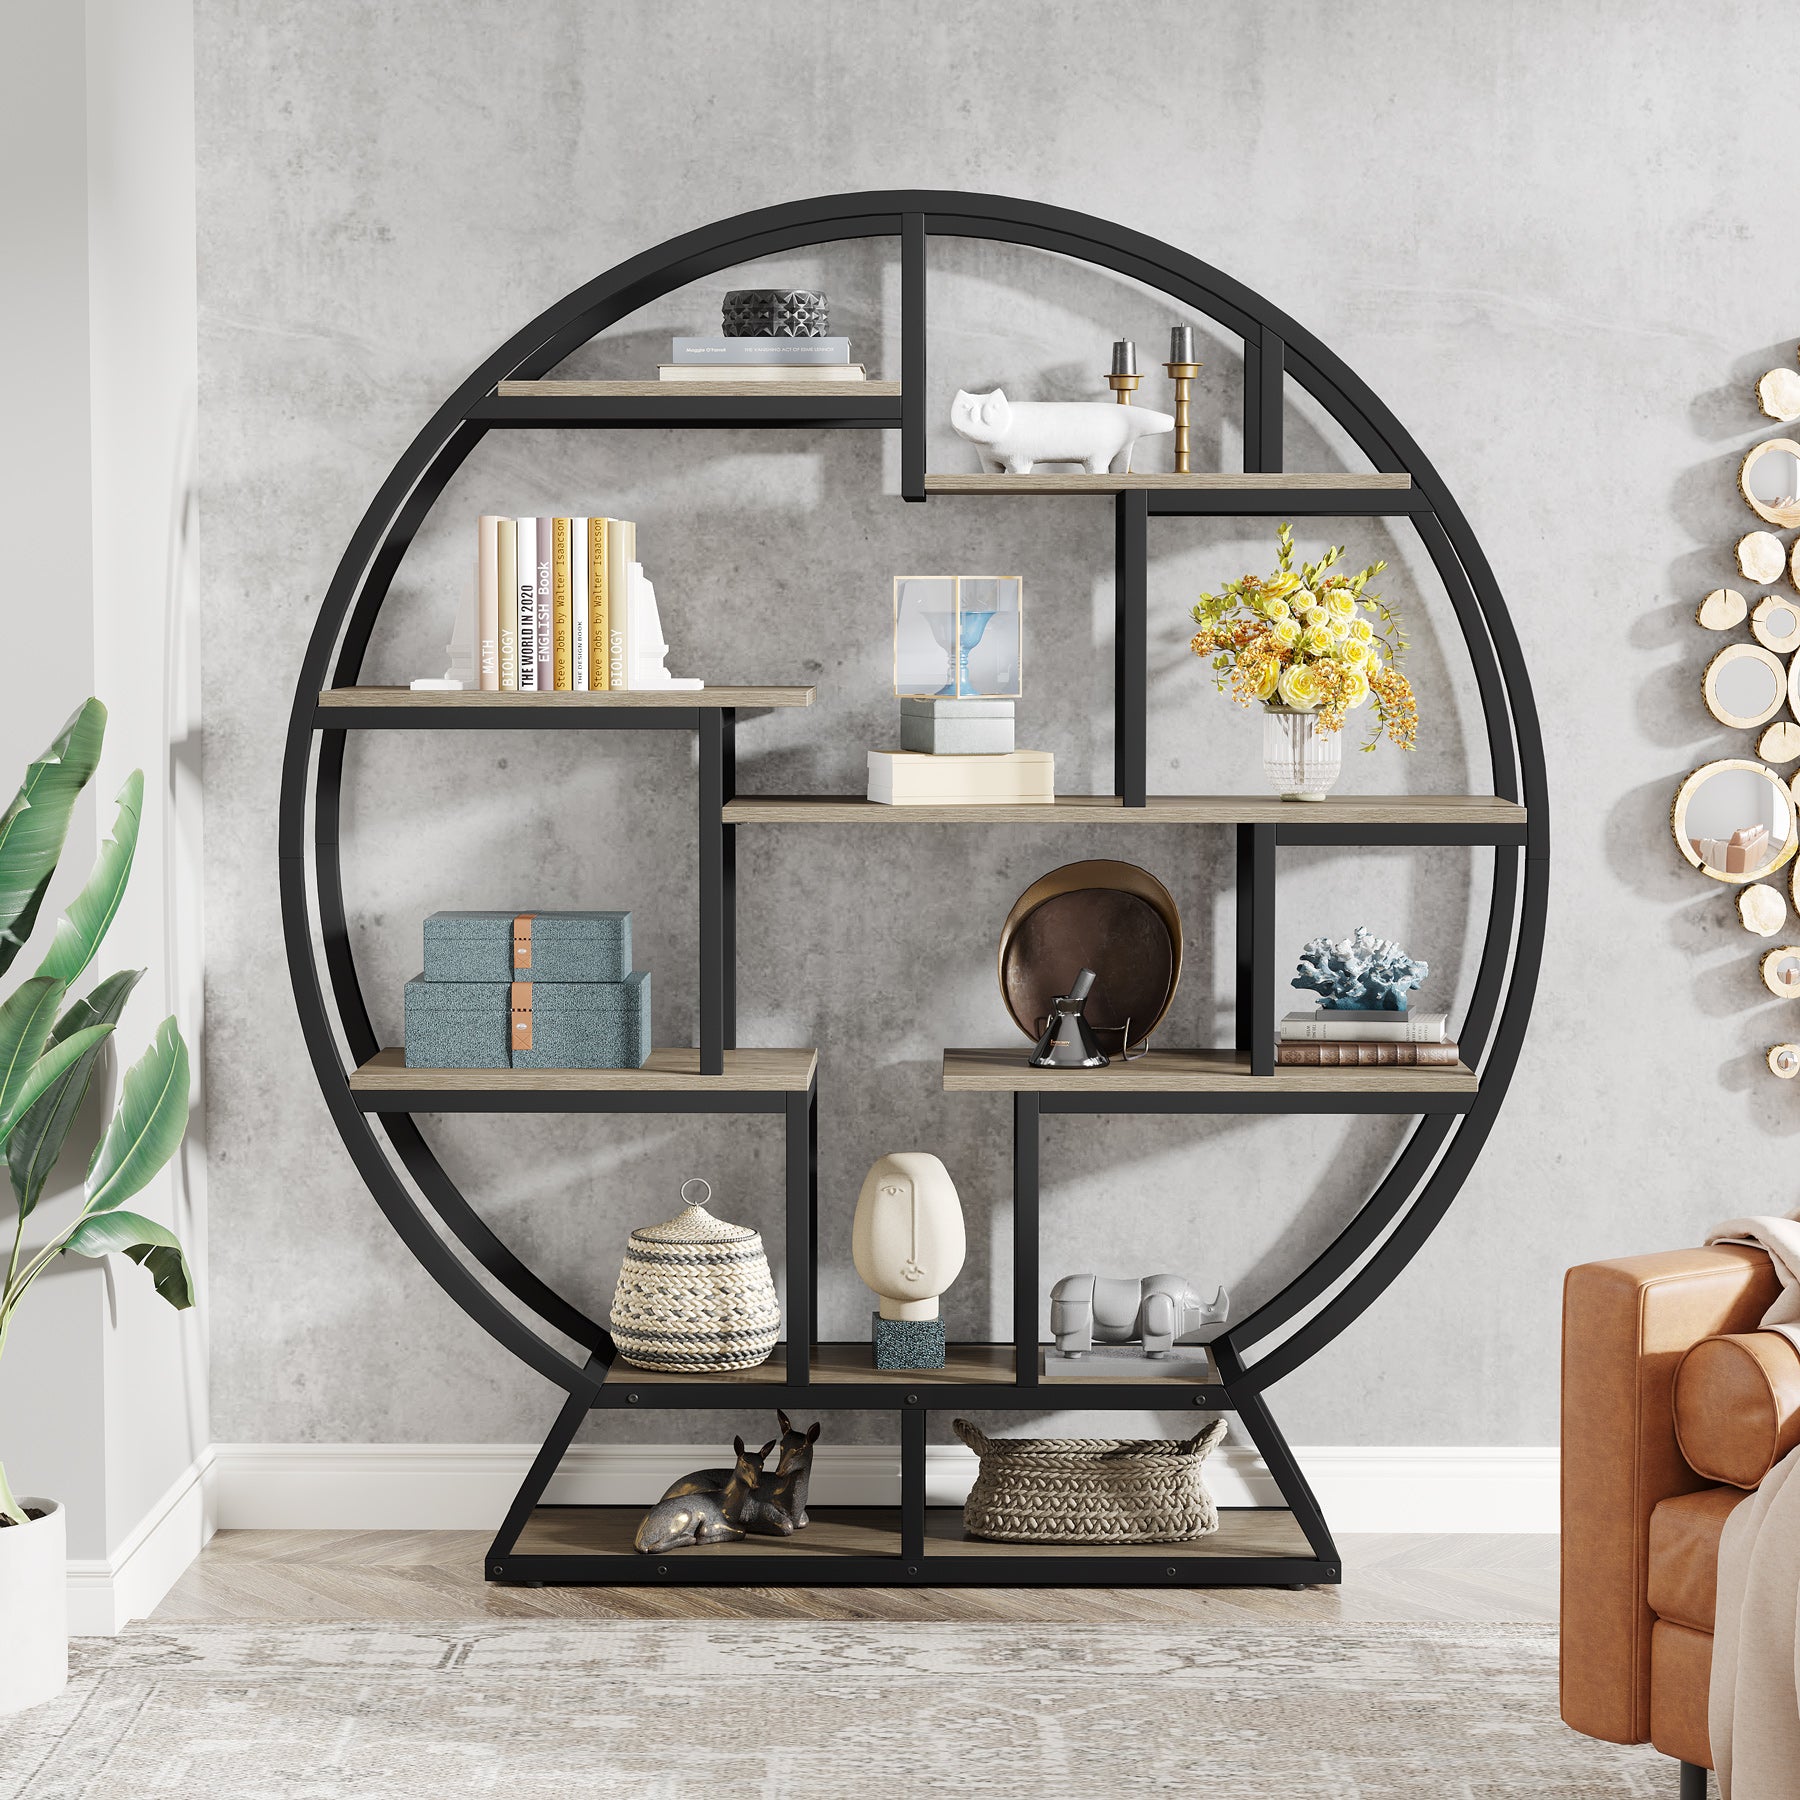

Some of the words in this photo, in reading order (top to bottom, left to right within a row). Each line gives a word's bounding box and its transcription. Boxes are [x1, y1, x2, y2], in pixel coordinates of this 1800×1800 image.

[556, 519, 566, 565] Isaacson
[593, 519, 603, 565] Isaacson
[537, 561, 550, 595] Book
[556, 571, 566, 607] Walter
[593, 571, 603, 607] Walter
[521, 585, 534, 613] 2020
[521, 616, 534, 626] IN
[538, 603, 550, 662] ENGLISH
[556, 612, 567, 624] by
[593, 612, 604, 624] by
[482, 639, 494, 674] MATH
[502, 629, 514, 687] BIOLOGY
[521, 628, 534, 666] WORLD
[556, 630, 566, 653] Jobs
[593, 630, 603, 653] Jobs
[611, 629, 623, 687] BIOLOGY
[521, 668, 534, 687] THE
[556, 659, 566, 688] Steve
[593, 659, 603, 688] Steve
